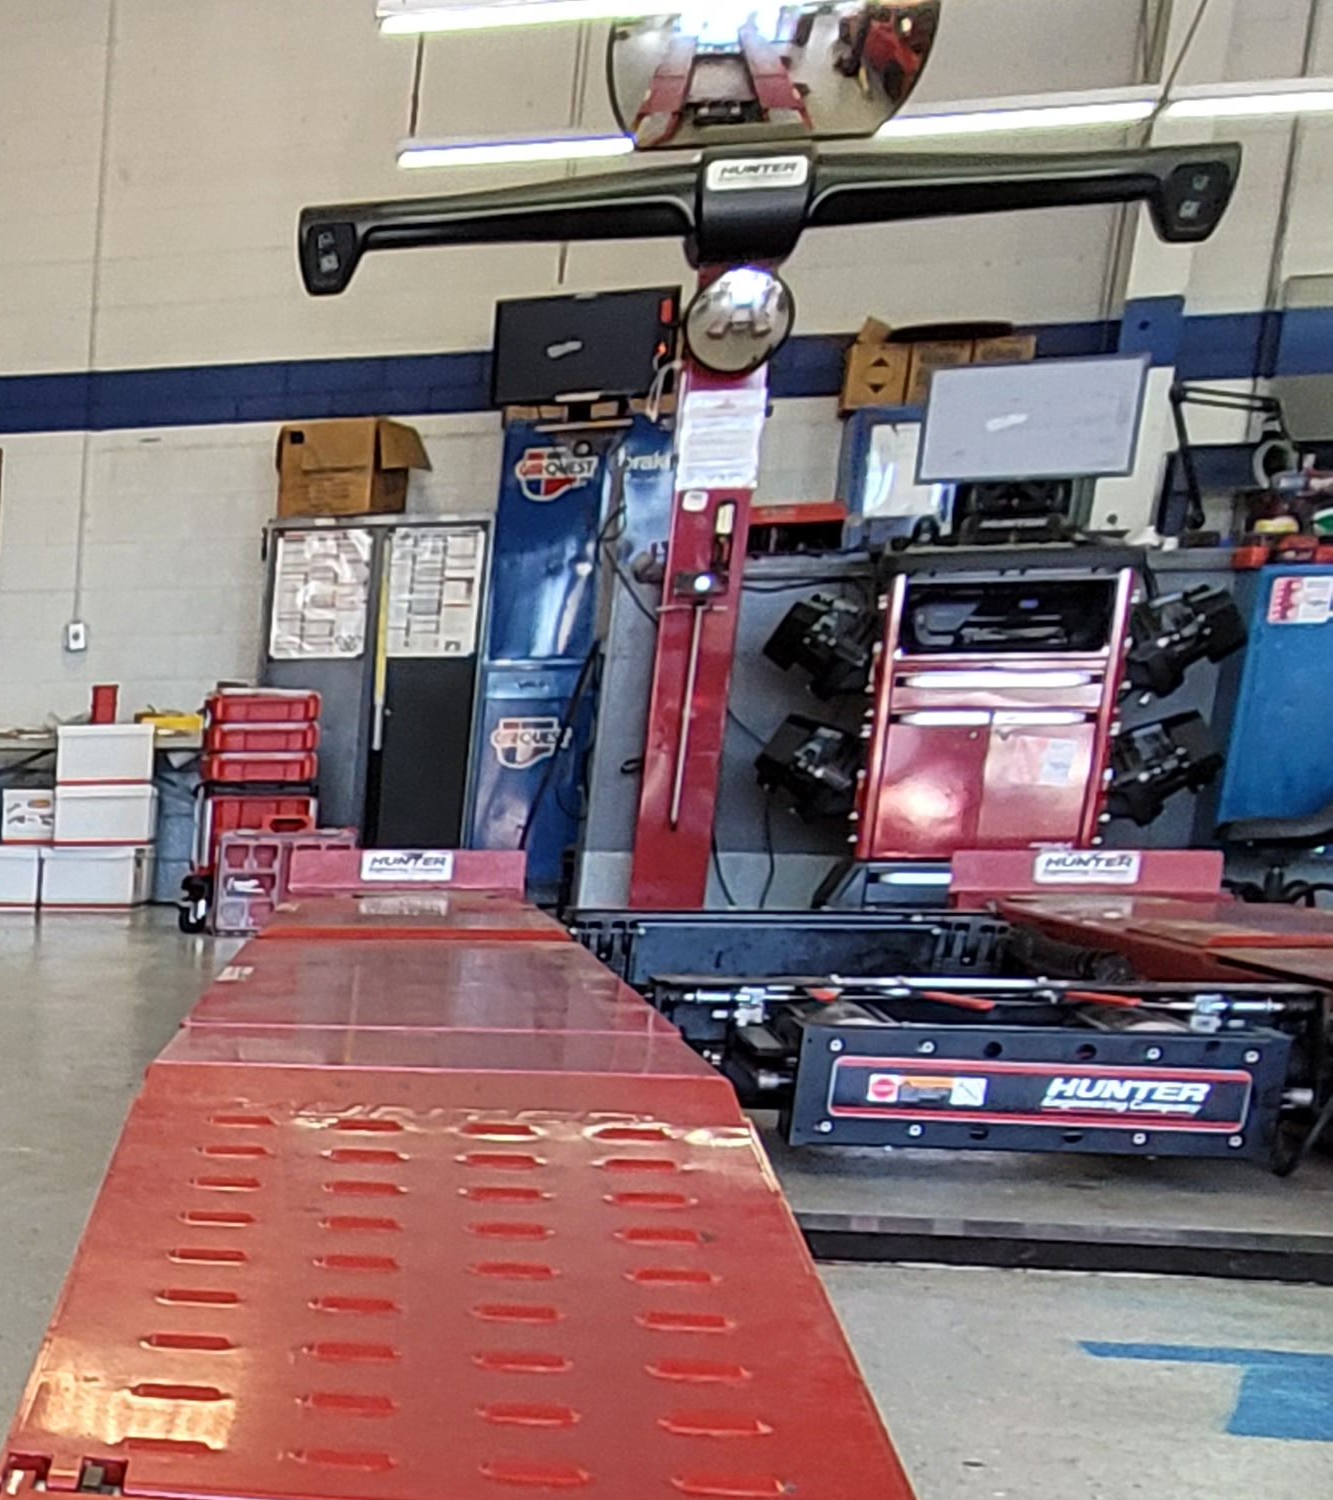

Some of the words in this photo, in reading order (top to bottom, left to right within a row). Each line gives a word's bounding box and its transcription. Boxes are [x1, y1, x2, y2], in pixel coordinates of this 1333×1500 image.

[720, 162, 799, 176] HUNTER
[370, 856, 447, 866] HUNTER
[1045, 855, 1133, 867] HUNTER
[1046, 1077, 1211, 1102] HUNTER
